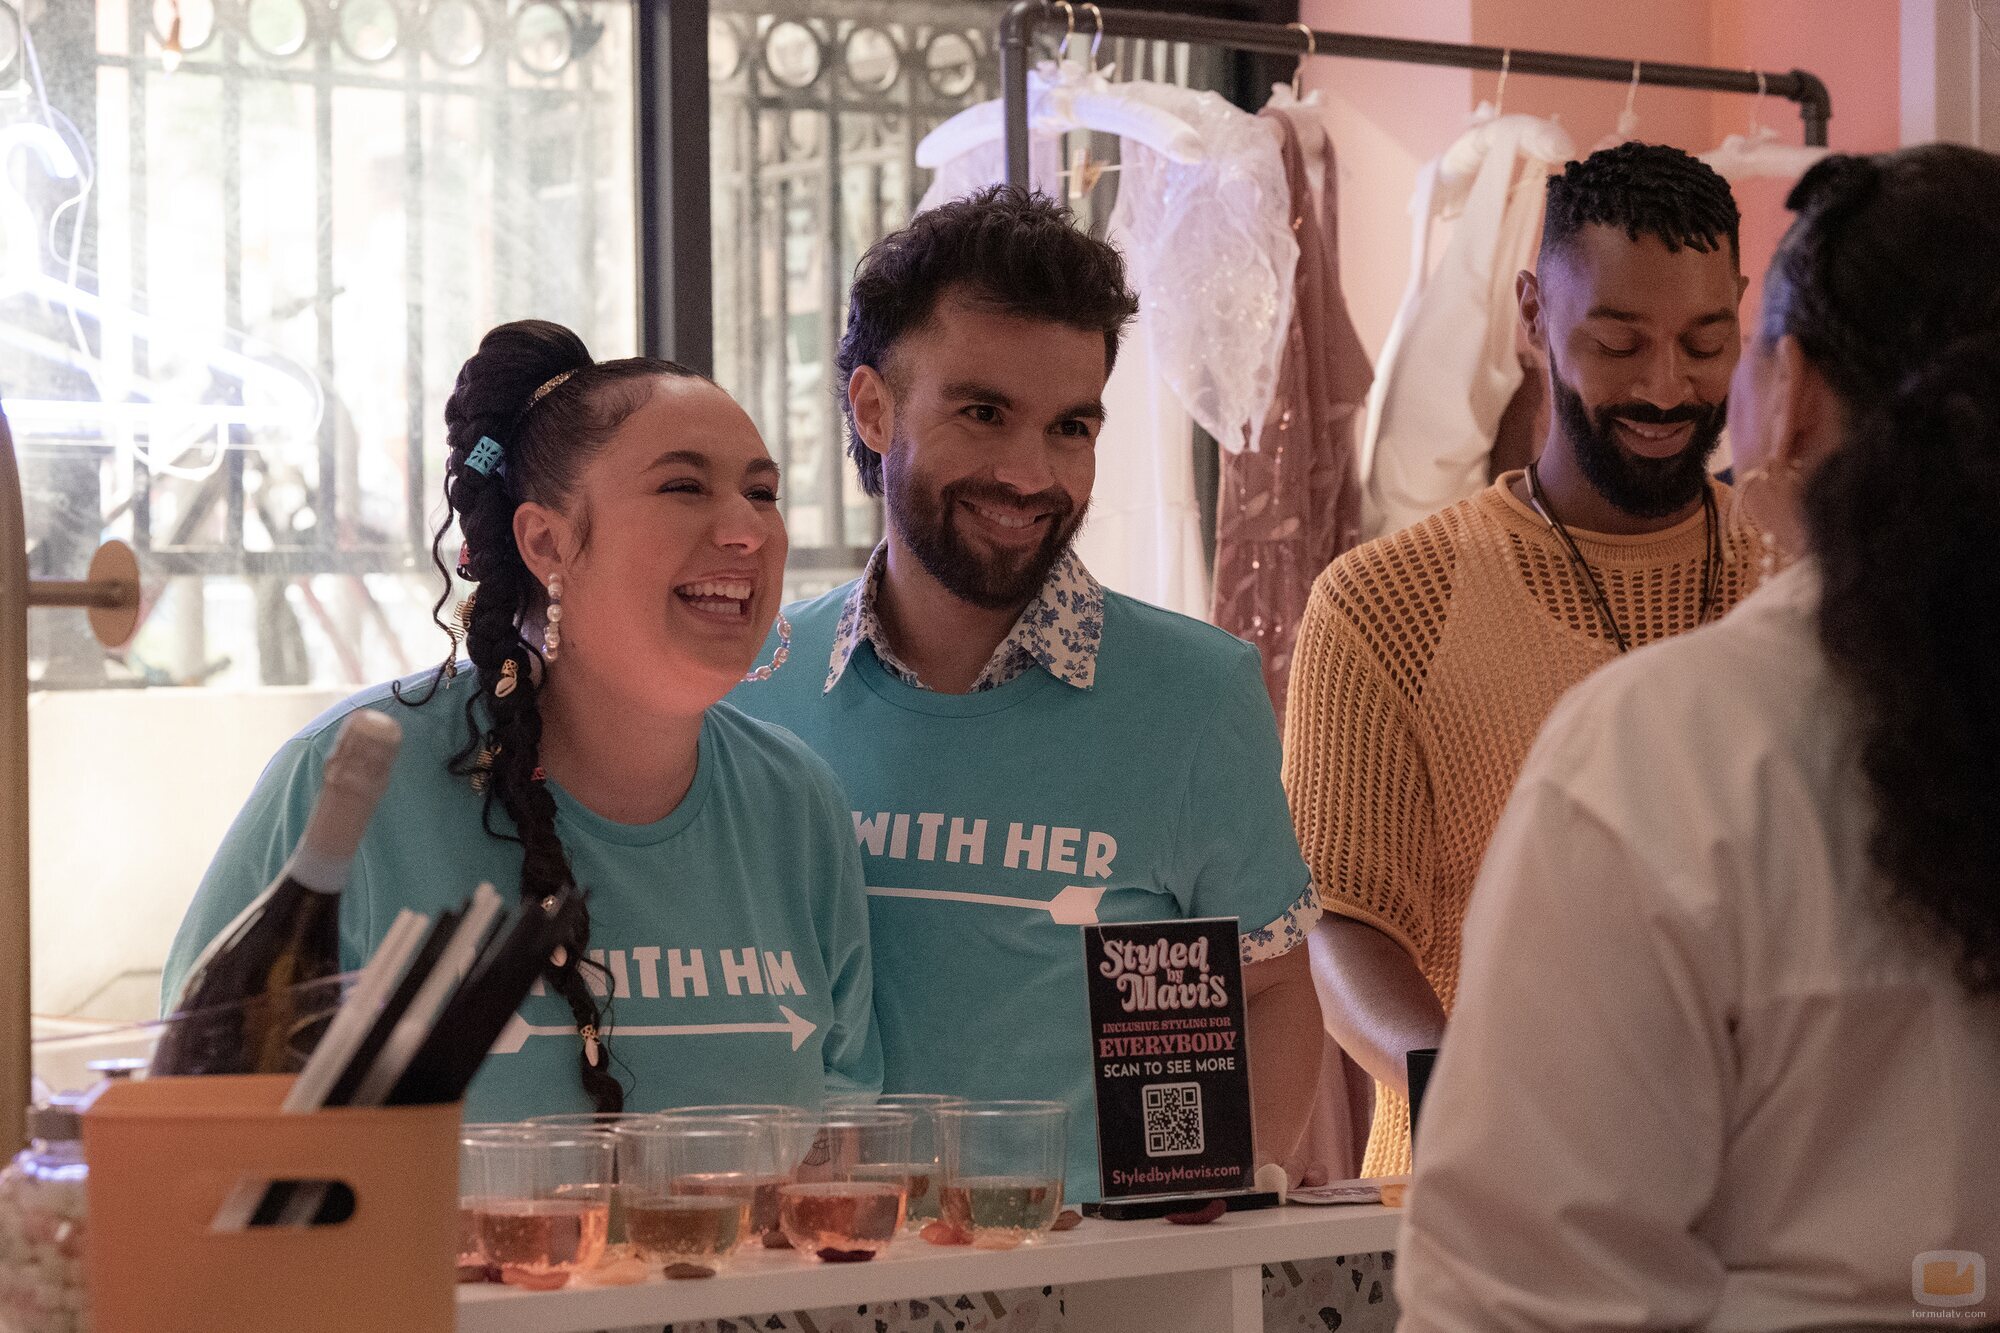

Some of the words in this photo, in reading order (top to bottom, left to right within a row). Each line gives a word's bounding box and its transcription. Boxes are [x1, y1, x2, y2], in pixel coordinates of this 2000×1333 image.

[851, 811, 988, 865] WITH
[1003, 822, 1118, 880] HER
[1100, 936, 1210, 978] Styled
[719, 946, 807, 996] HM
[1166, 967, 1184, 985] by
[1102, 1020, 1159, 1034] INCLUSIVE
[1161, 1018, 1208, 1031] STYLING
[1208, 1016, 1232, 1028] FOR
[1099, 1031, 1238, 1058] EVERYBODY
[1103, 1062, 1141, 1078] SCAN
[1144, 1061, 1163, 1076] TO
[1166, 1059, 1192, 1074] SEE
[1195, 1056, 1236, 1073] MORE
[1112, 1165, 1241, 1187] StyledbyMavis.com
